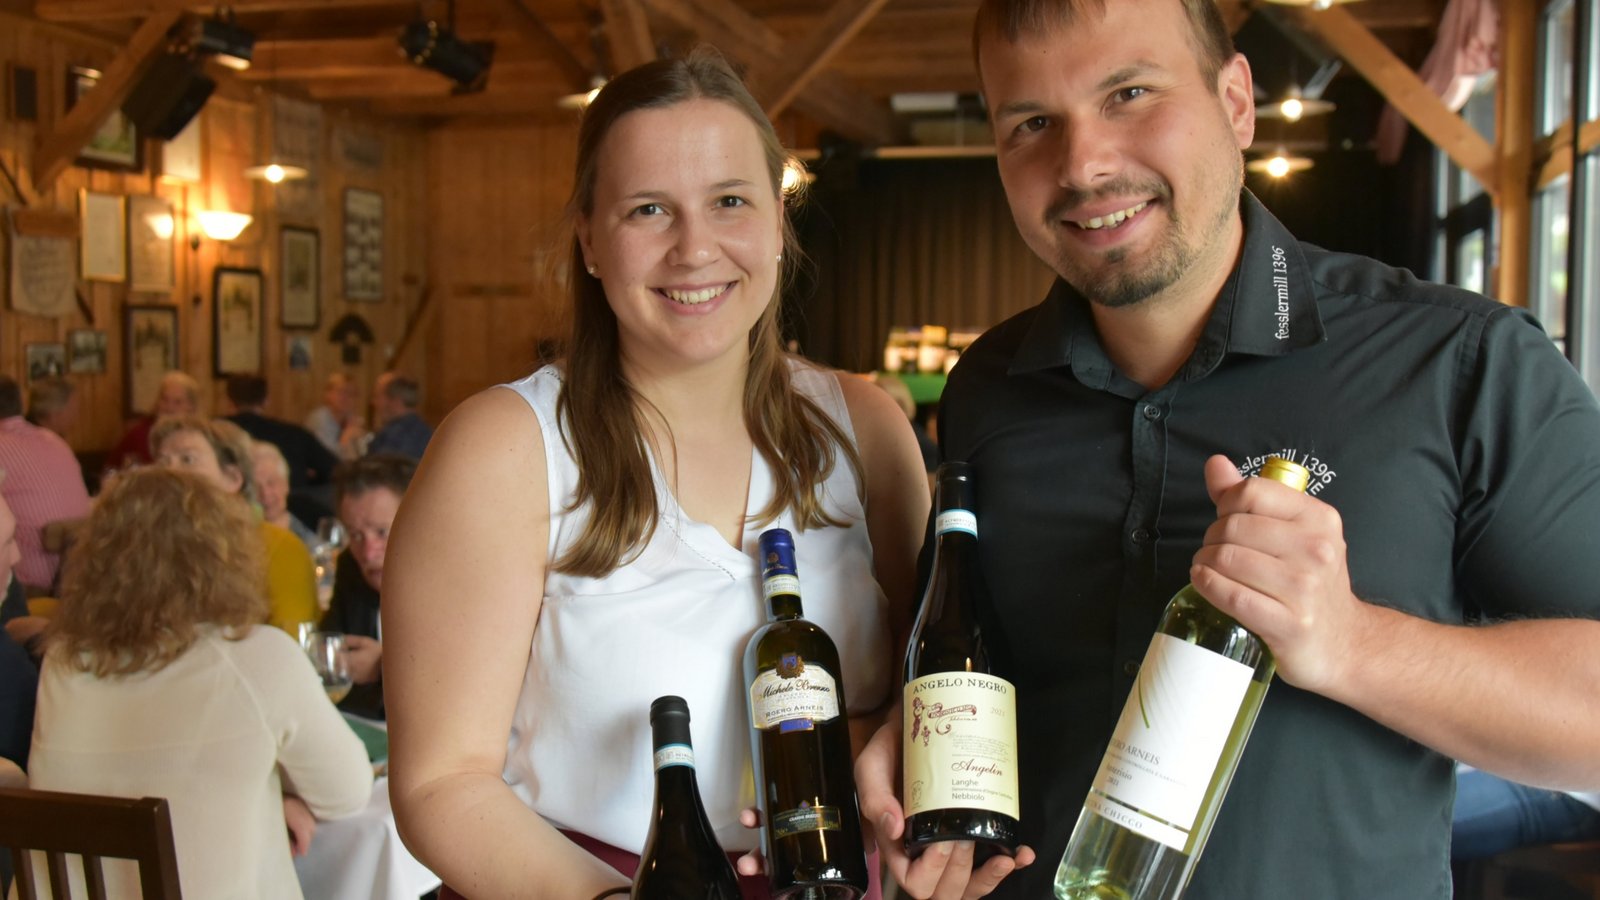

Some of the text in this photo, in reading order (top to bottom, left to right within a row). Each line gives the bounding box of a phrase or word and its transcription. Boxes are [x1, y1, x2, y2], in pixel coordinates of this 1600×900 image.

[1271, 245, 1290, 340] fesslermill 1396
[1237, 448, 1337, 485] sslerill 1396
[913, 677, 1007, 695] ANGELO NEGRO
[765, 707, 792, 718] ROERO
[793, 704, 824, 712] ARNEIS
[1125, 743, 1161, 766] ARNEIS
[951, 758, 1003, 778] Angelin
[951, 778, 979, 787] Langhe
[951, 792, 985, 801] Nebbiolo
[1103, 806, 1143, 829] CHICCO
